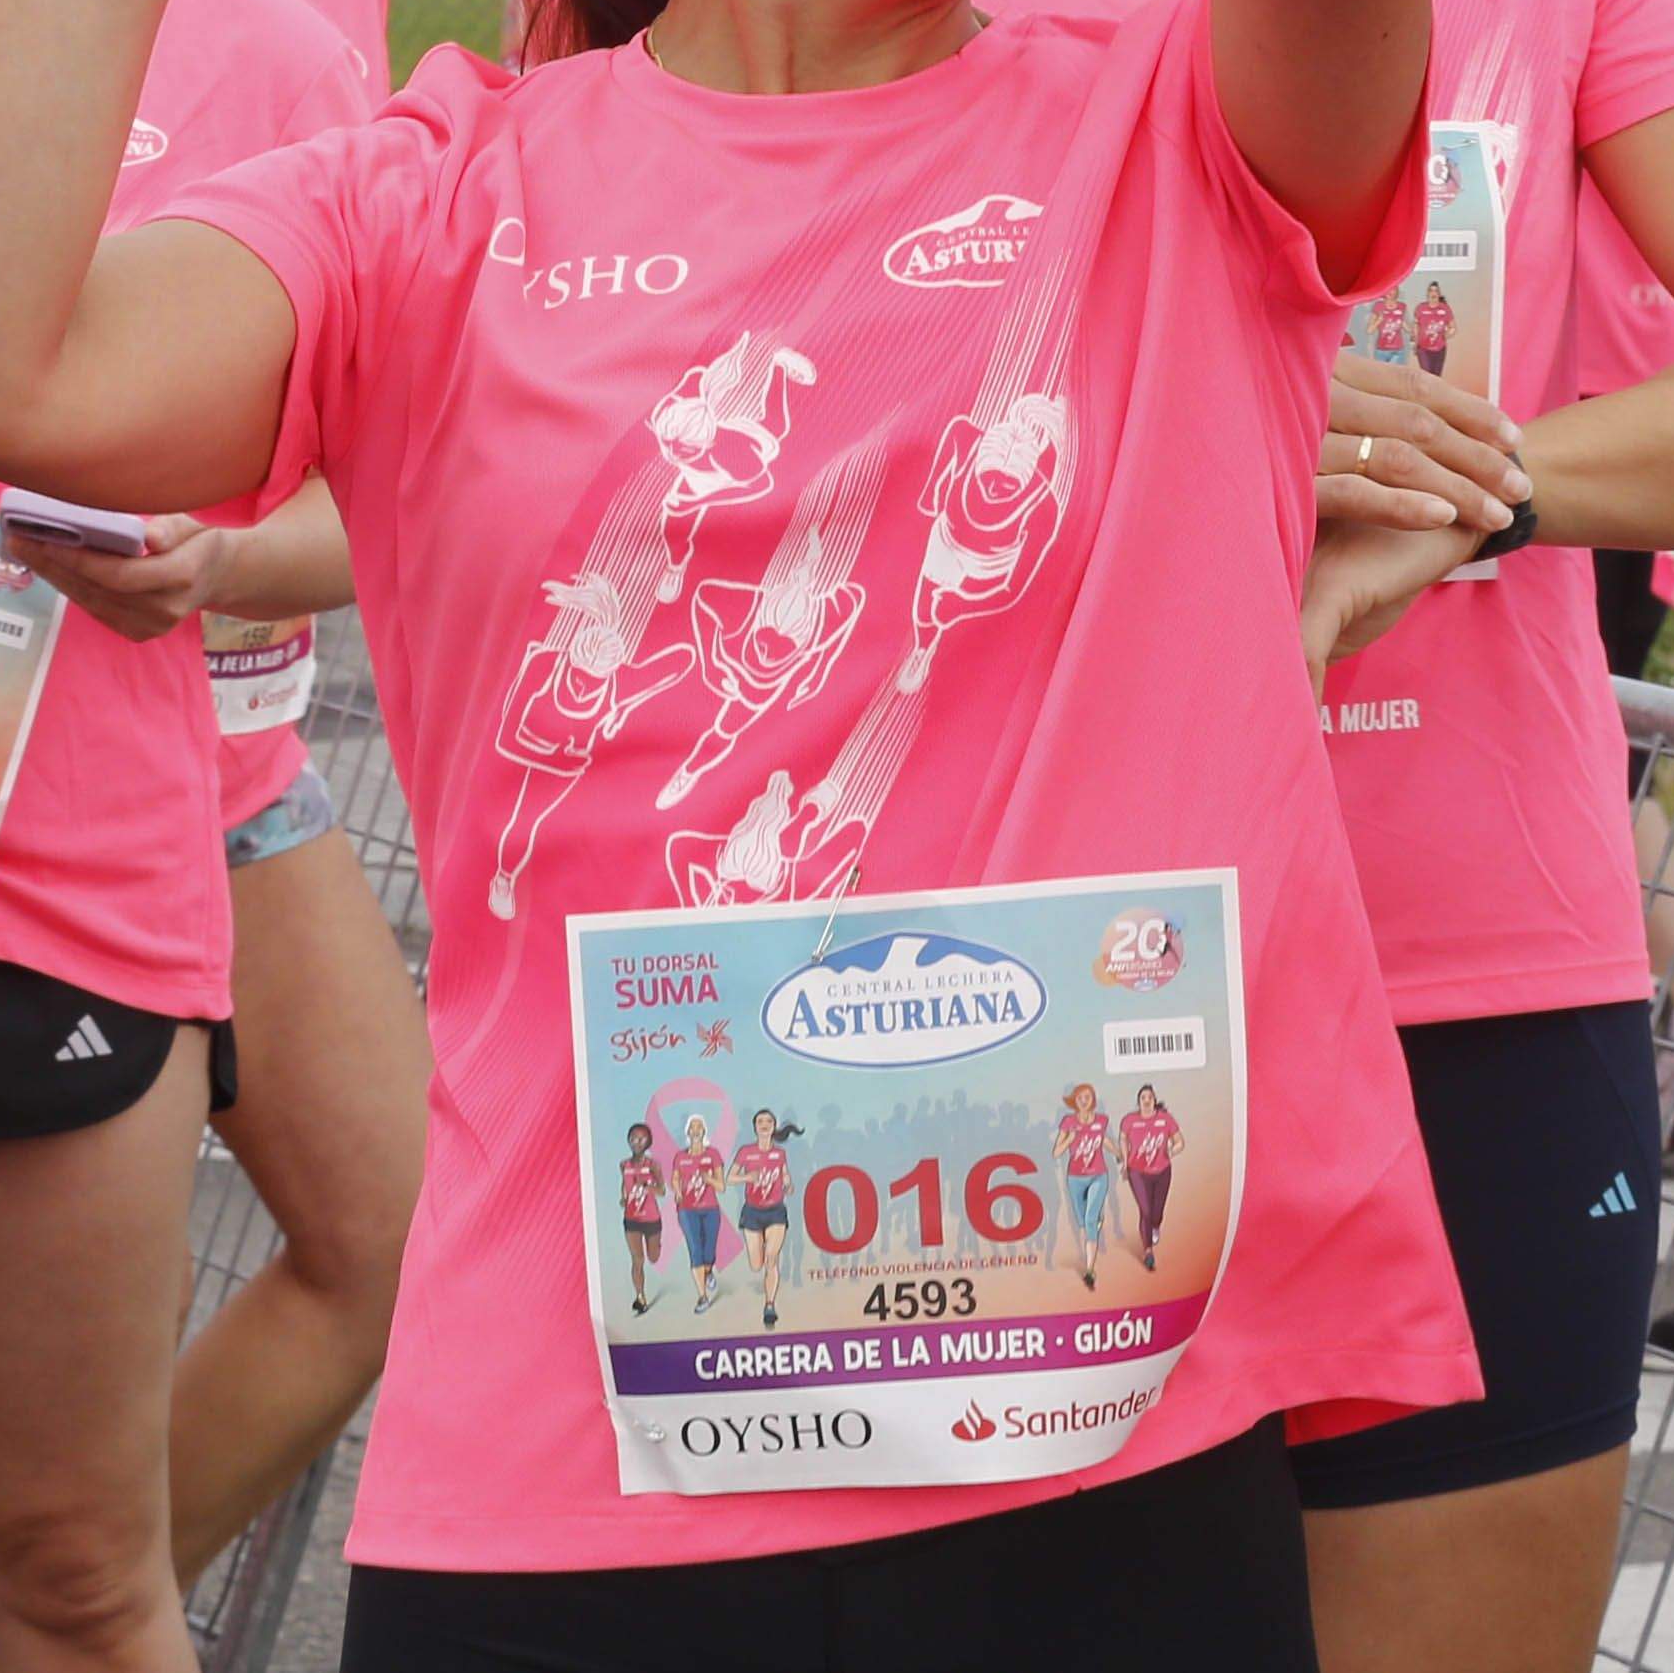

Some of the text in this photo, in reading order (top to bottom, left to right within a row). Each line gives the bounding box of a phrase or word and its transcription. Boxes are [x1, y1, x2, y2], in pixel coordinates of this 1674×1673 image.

[901, 239, 1026, 277] ASTUR
[1318, 697, 1420, 734] A MUJER
[1111, 918, 1167, 962] 20
[611, 952, 720, 976] TU DORSAL
[827, 970, 1015, 998] CENTRAL LECHERA
[614, 974, 720, 1010] SUMA
[784, 989, 1027, 1040] ASTURIANA
[610, 1024, 687, 1063] gijón
[803, 1151, 1045, 1255] 016
[882, 1260, 958, 1275] VIOLENCIA
[959, 1258, 976, 1270] DE
[863, 1277, 977, 1322] 4593
[694, 1311, 1153, 1381] CARRERA DE LA MUJER GIJÓN
[681, 1408, 873, 1458] OYSHO
[1004, 1385, 1157, 1440] Santander
